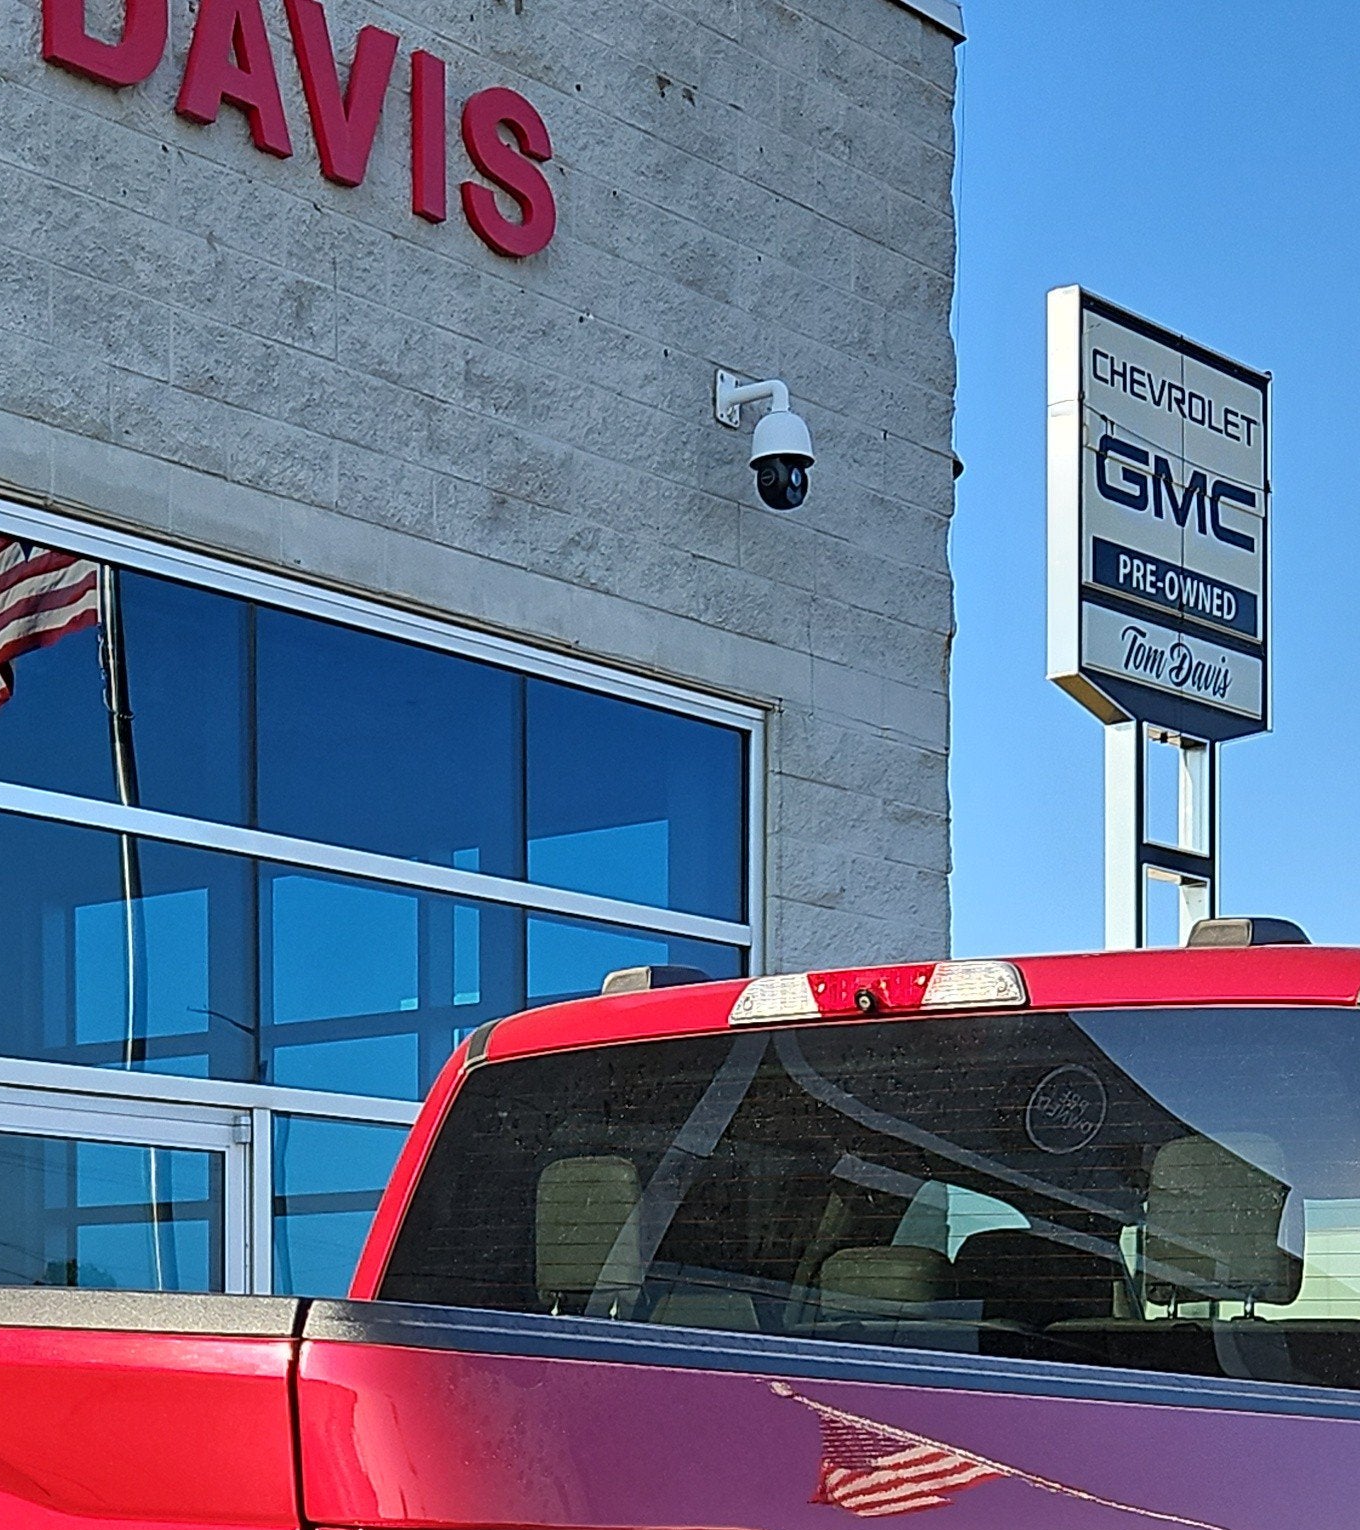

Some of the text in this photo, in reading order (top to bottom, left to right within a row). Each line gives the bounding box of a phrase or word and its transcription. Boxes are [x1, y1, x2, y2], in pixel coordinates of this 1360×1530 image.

[1092, 348, 1258, 447] CHEVROLET
[1095, 433, 1257, 553] GMC
[1118, 553, 1237, 622] PRE-OWNED
[1121, 625, 1233, 699] Tom Davis
